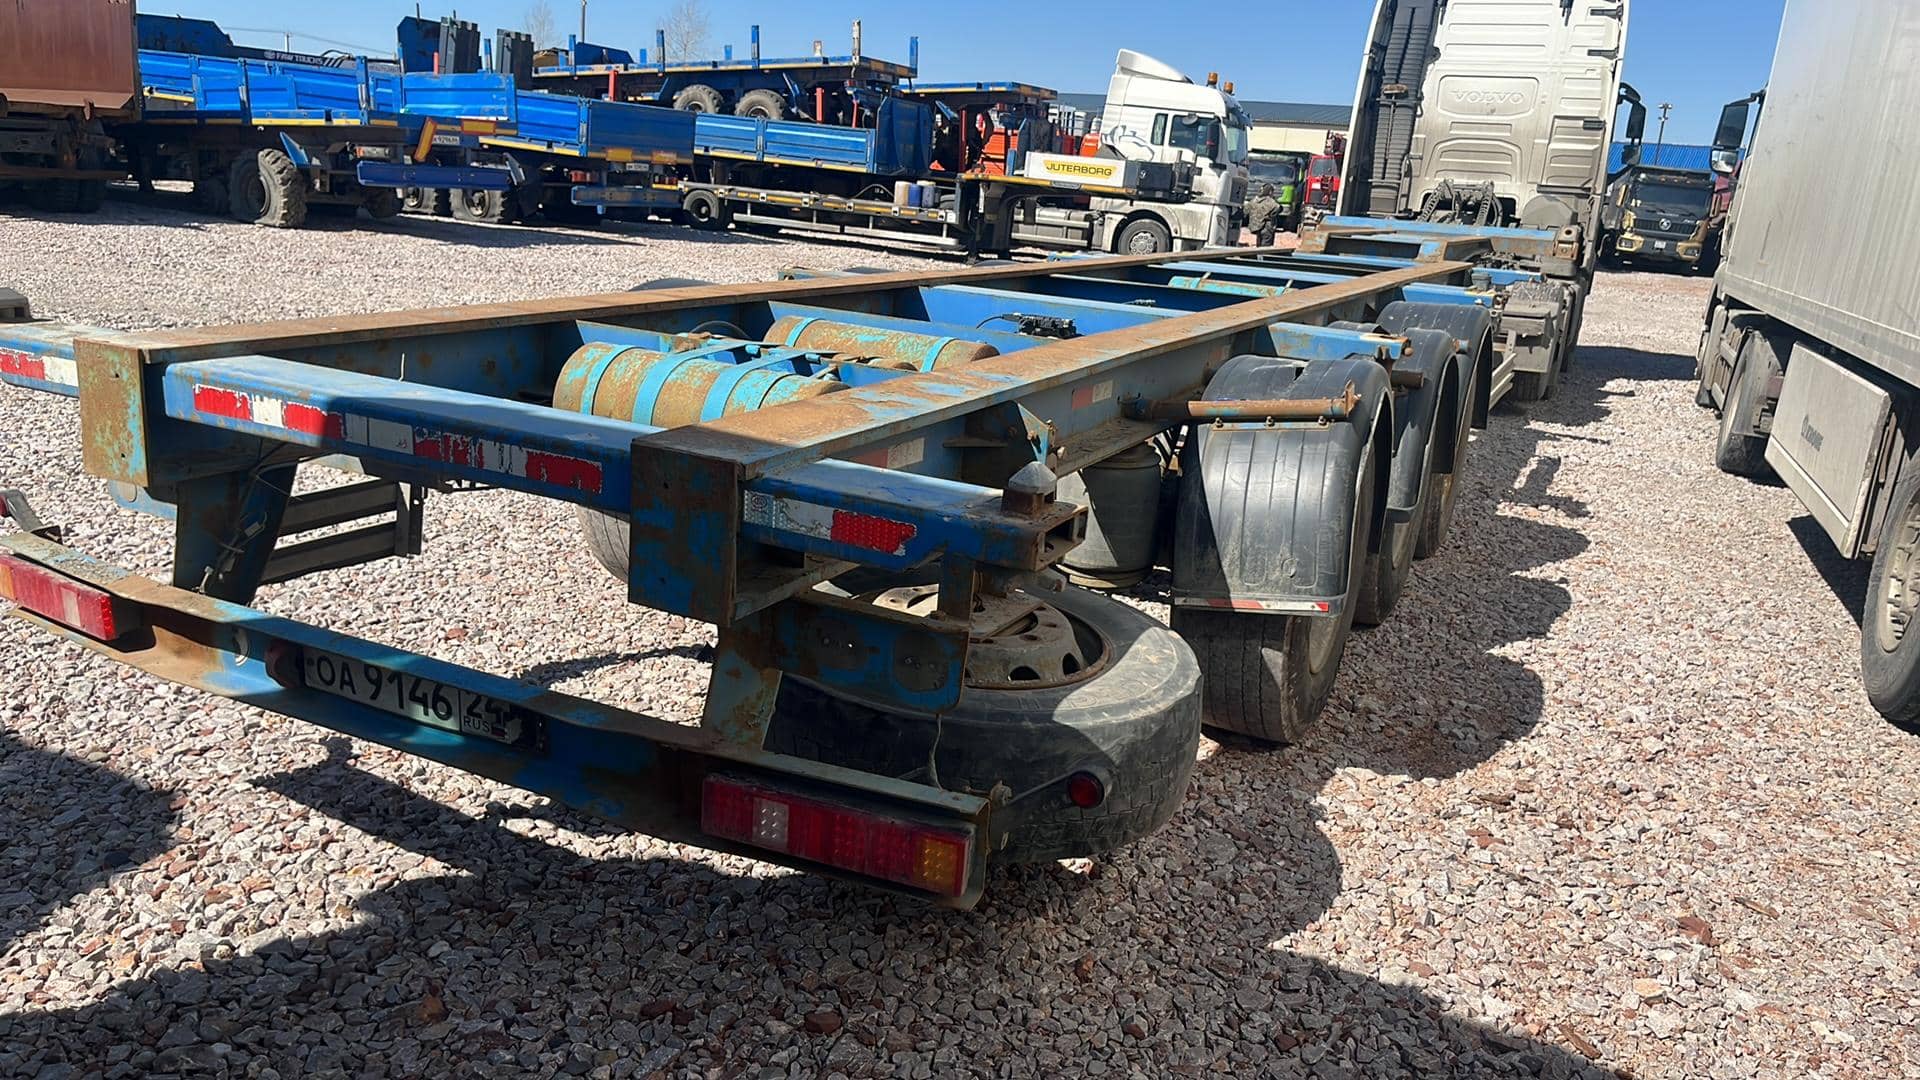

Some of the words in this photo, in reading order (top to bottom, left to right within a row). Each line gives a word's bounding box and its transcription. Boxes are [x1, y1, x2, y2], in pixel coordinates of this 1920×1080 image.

[1448, 90, 1524, 104] VOLVO
[1046, 162, 1112, 176] JUTERBORG
[364, 664, 453, 721] 9146
[463, 715, 490, 733] RUS
